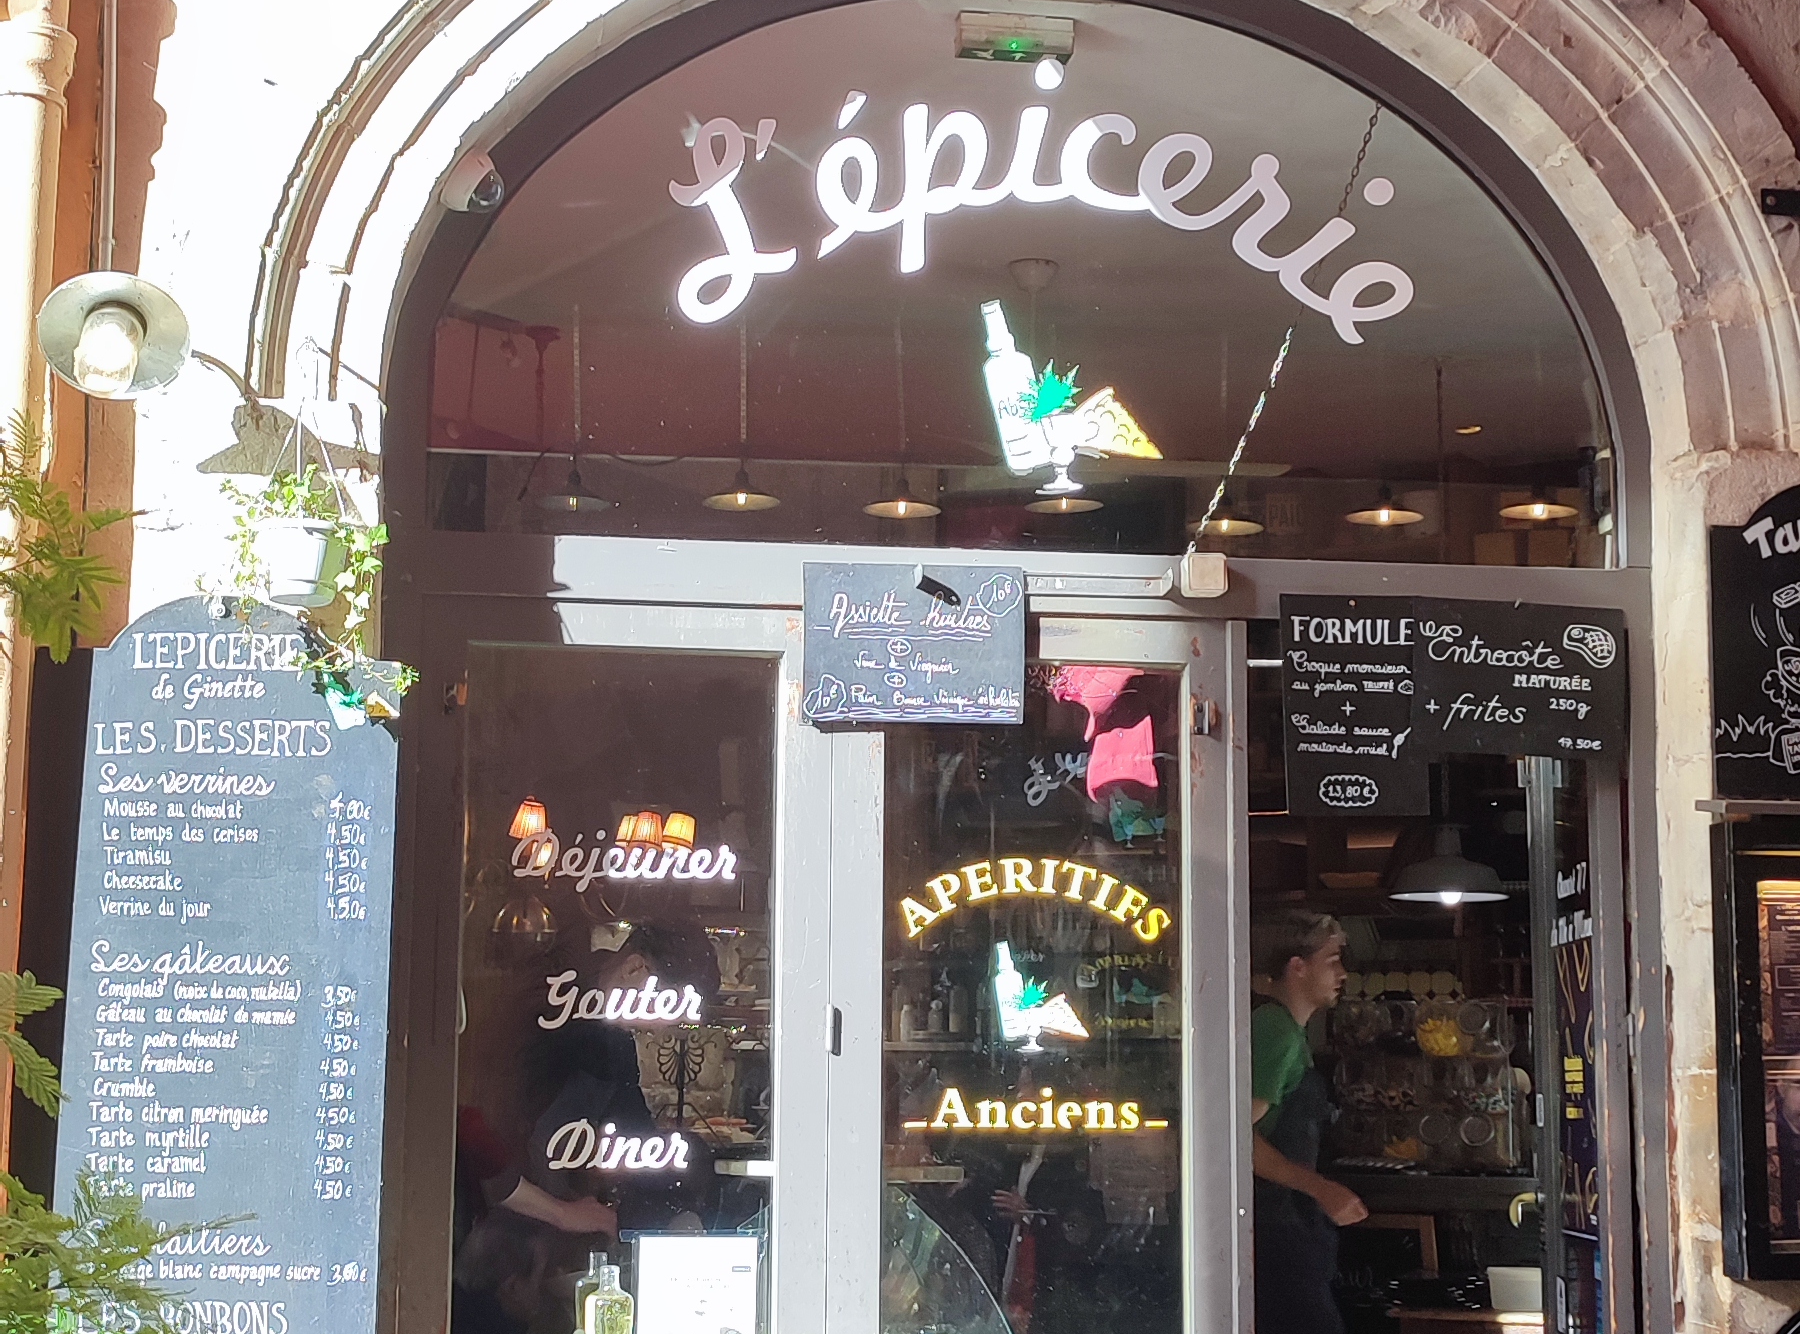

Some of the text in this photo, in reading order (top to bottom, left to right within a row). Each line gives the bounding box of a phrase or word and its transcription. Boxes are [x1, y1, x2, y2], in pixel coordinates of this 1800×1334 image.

[668, 58, 1415, 345] L'épicerie
[1290, 616, 1415, 645] FORMULE
[1420, 621, 1565, 669] Entrecôte
[1287, 650, 1342, 679] Croque
[151, 672, 267, 711] de Ginette
[1291, 681, 1310, 690] au
[1313, 679, 1358, 698] jambon
[1512, 673, 1592, 691] MATURÉE
[1290, 713, 1392, 736] Salade sauce
[1443, 692, 1528, 731] frites
[93, 719, 333, 757] LES DESSERTS
[1354, 743, 1390, 756] miel
[157, 764, 276, 797] verrines
[104, 797, 159, 818] Mousse
[167, 802, 186, 818] au
[191, 798, 244, 820] chocolat
[102, 822, 121, 841] Le
[130, 822, 174, 847] temps
[181, 822, 205, 842] des
[213, 824, 259, 843] cerises
[103, 844, 172, 866] Tiramisu
[510, 827, 738, 894] Déjeuner
[103, 868, 184, 892] Cheesecake
[98, 895, 152, 917] Verrine
[158, 896, 176, 917] du
[180, 897, 212, 925] jour
[898, 855, 1173, 944] APERITIFS
[151, 940, 291, 986] gâteaux
[97, 977, 165, 1006] Congolais
[537, 968, 704, 1031] Gouter
[95, 1002, 146, 1024] Gâteau
[155, 1006, 174, 1024] au
[177, 1002, 228, 1024] chocolat
[95, 1028, 135, 1048] Tarte
[142, 1030, 178, 1054] poire
[181, 1028, 240, 1050] chocolat
[91, 1051, 133, 1072] Tarte
[140, 1051, 215, 1074] framboise
[93, 1076, 157, 1099] Crumble
[88, 1101, 133, 1123] Tarte
[141, 1100, 185, 1124] citron
[190, 1104, 270, 1131] meringuée
[932, 1086, 1142, 1132] Anciens
[86, 1126, 136, 1148] Tarte
[145, 1124, 210, 1157] myrtille
[546, 1117, 690, 1170] Diner
[85, 1151, 135, 1174] Tarte
[146, 1149, 207, 1175] caramel
[141, 1177, 197, 1204] praline
[159, 1259, 203, 1280] blanc
[209, 1262, 282, 1287] campagne
